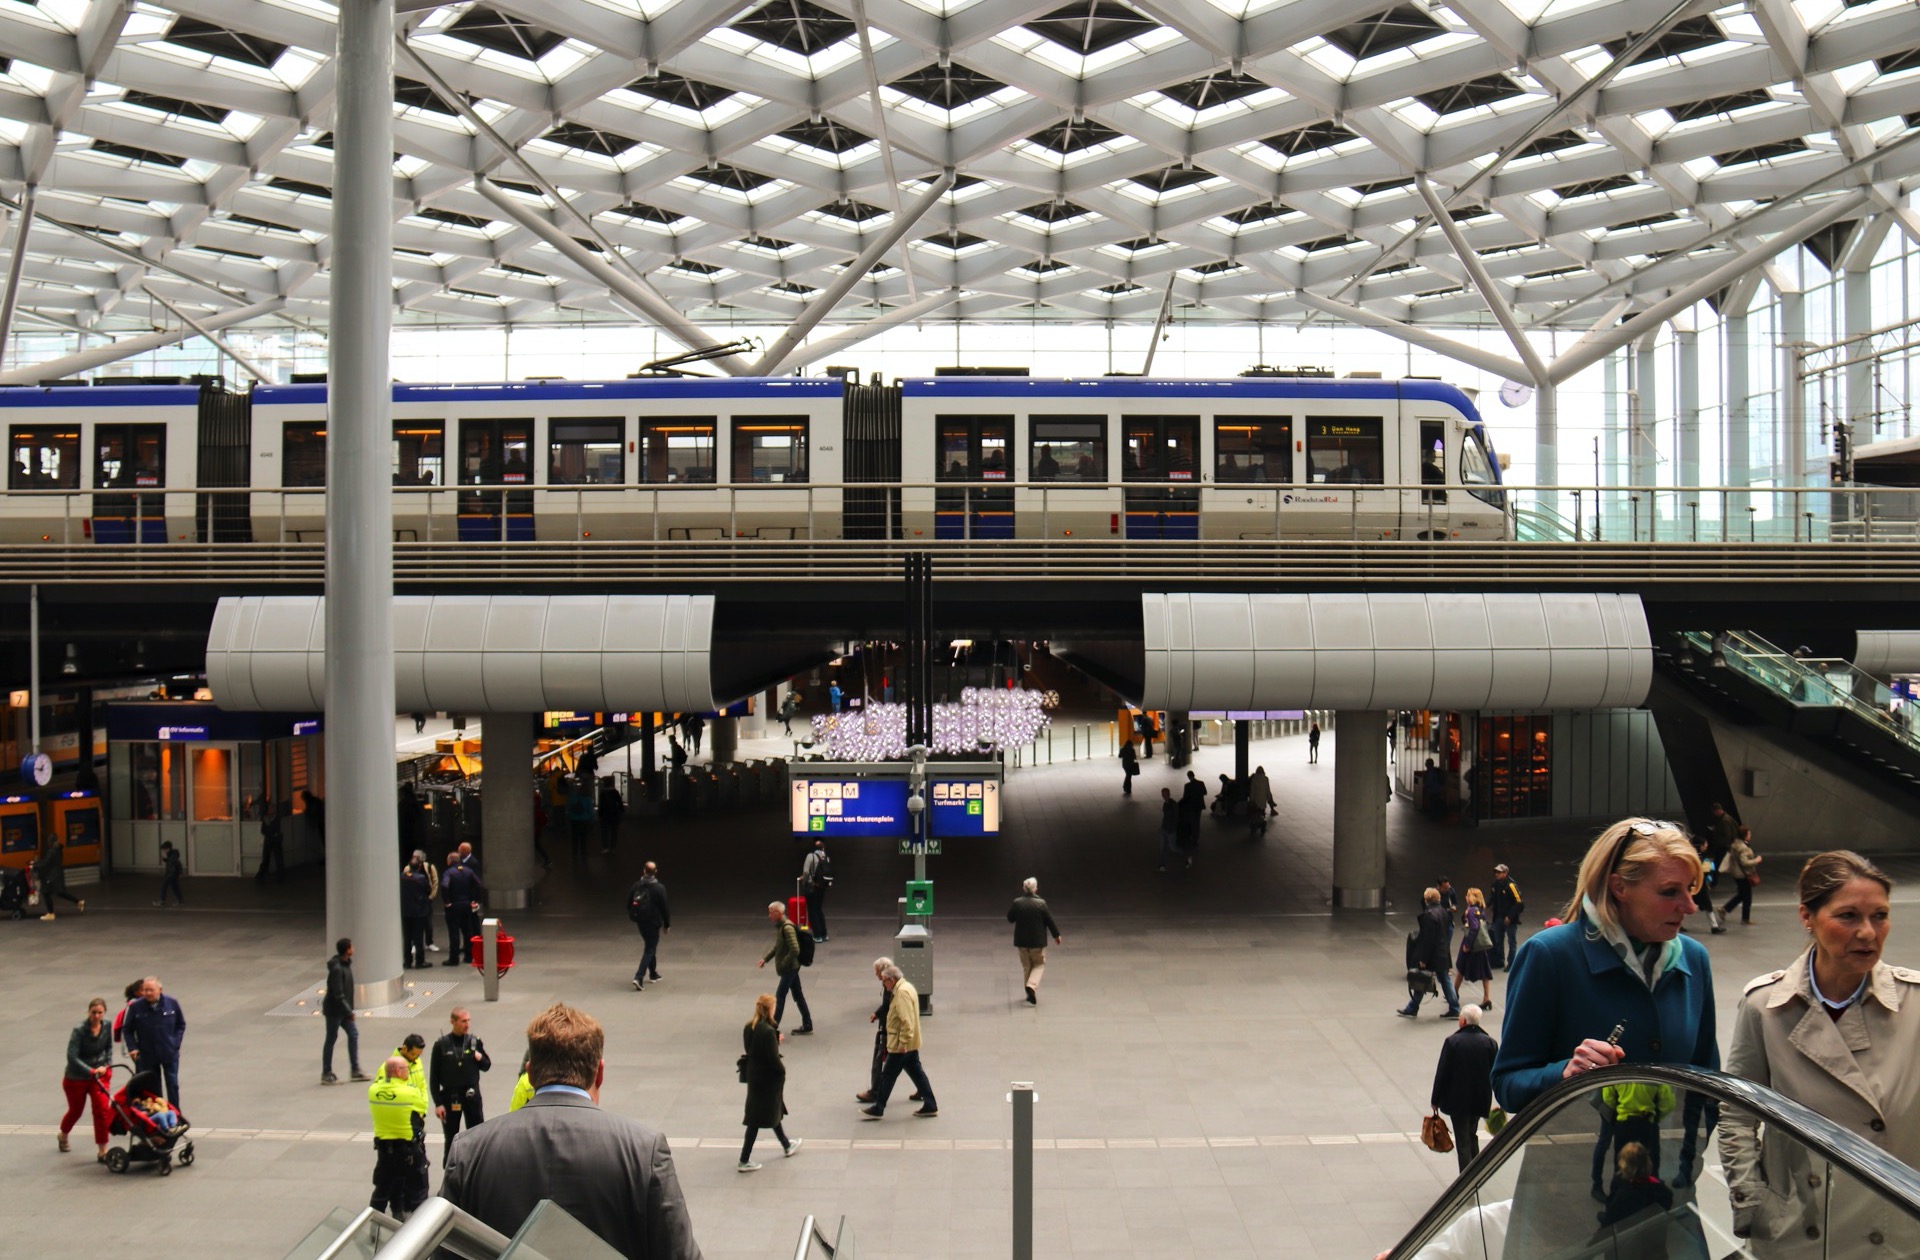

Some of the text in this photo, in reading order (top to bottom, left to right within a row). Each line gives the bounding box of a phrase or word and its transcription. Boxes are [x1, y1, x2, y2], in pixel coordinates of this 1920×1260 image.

[1321, 425, 1327, 435] 3
[15, 694, 23, 706] 7
[856, 815, 894, 824] Buerenplein
